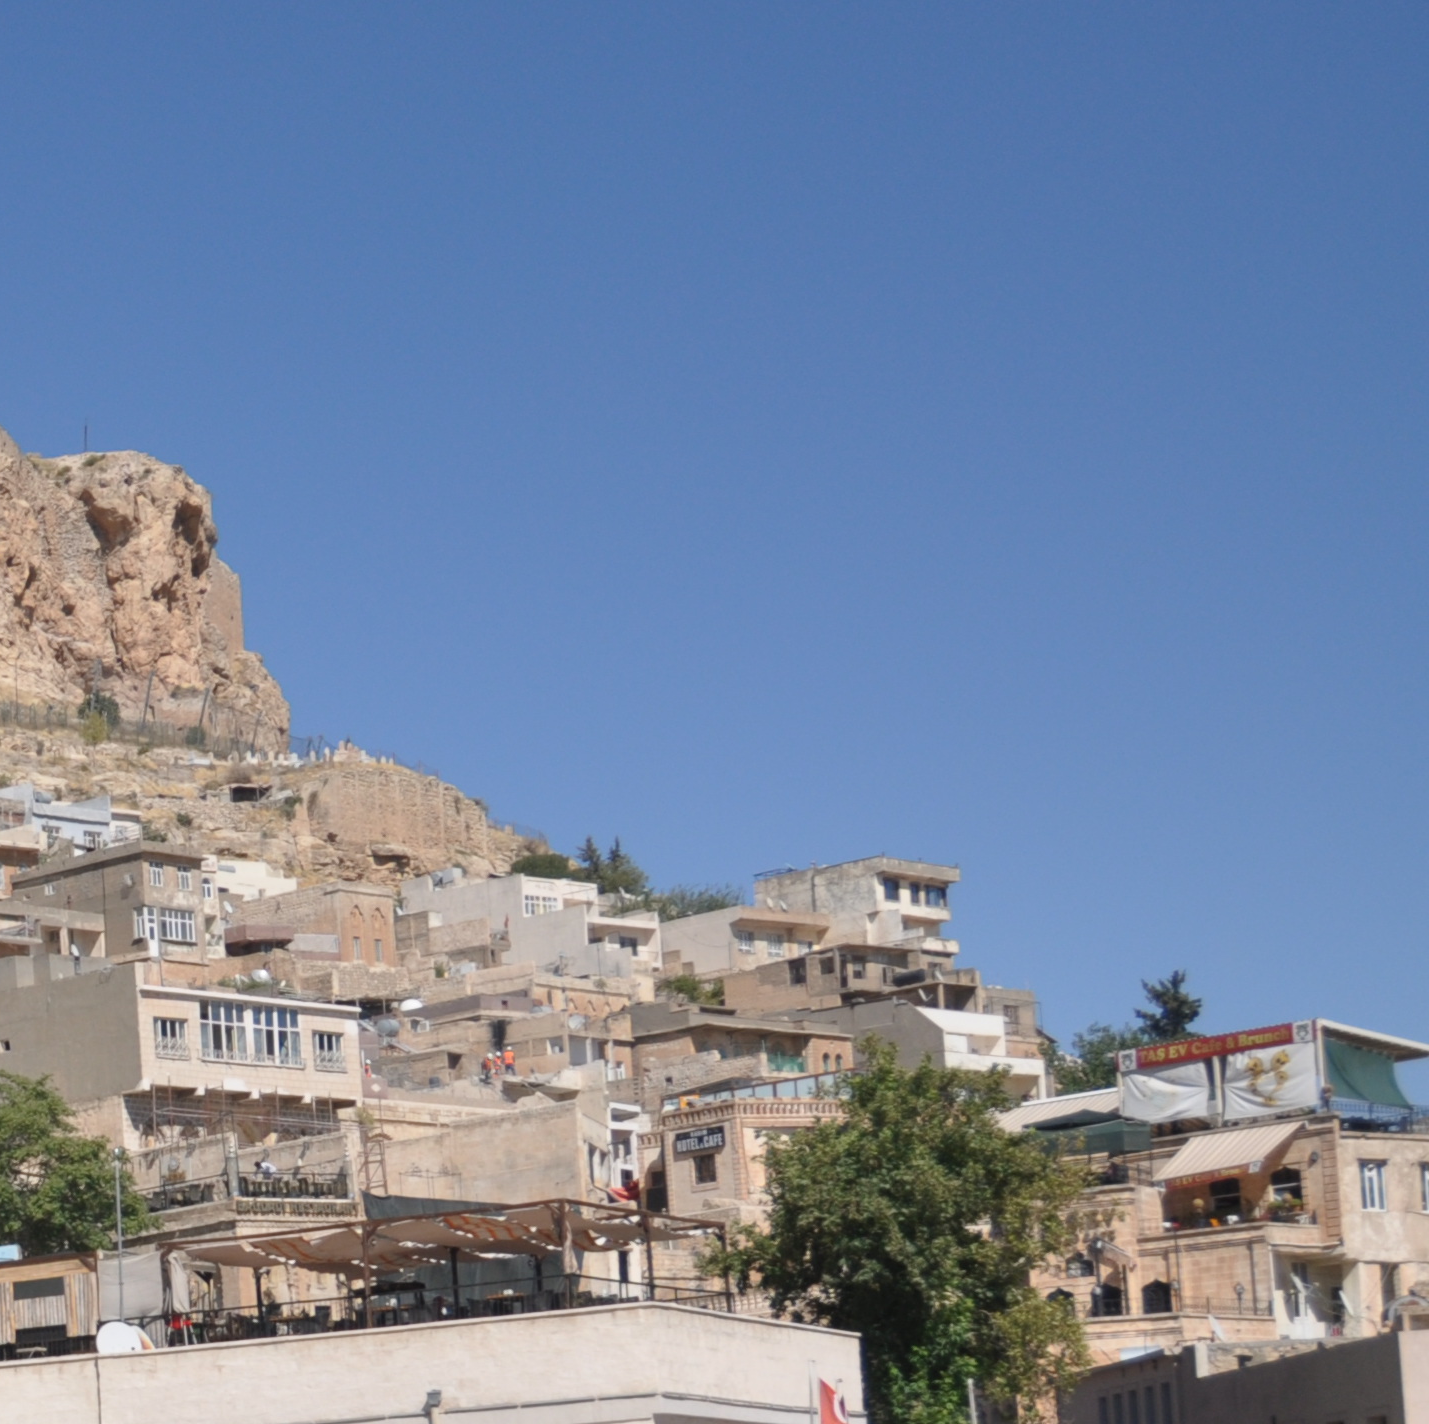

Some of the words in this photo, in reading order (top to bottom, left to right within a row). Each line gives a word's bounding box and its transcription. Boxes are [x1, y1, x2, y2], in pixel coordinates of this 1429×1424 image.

[1138, 1047, 1165, 1063] TAŞ
[1168, 1044, 1190, 1059] EV
[1192, 1038, 1222, 1055] Cafe
[1226, 1037, 1235, 1049] &
[1238, 1027, 1291, 1048] Brunch
[676, 1138, 700, 1152] HOTEL
[703, 1133, 722, 1148] CAFE
